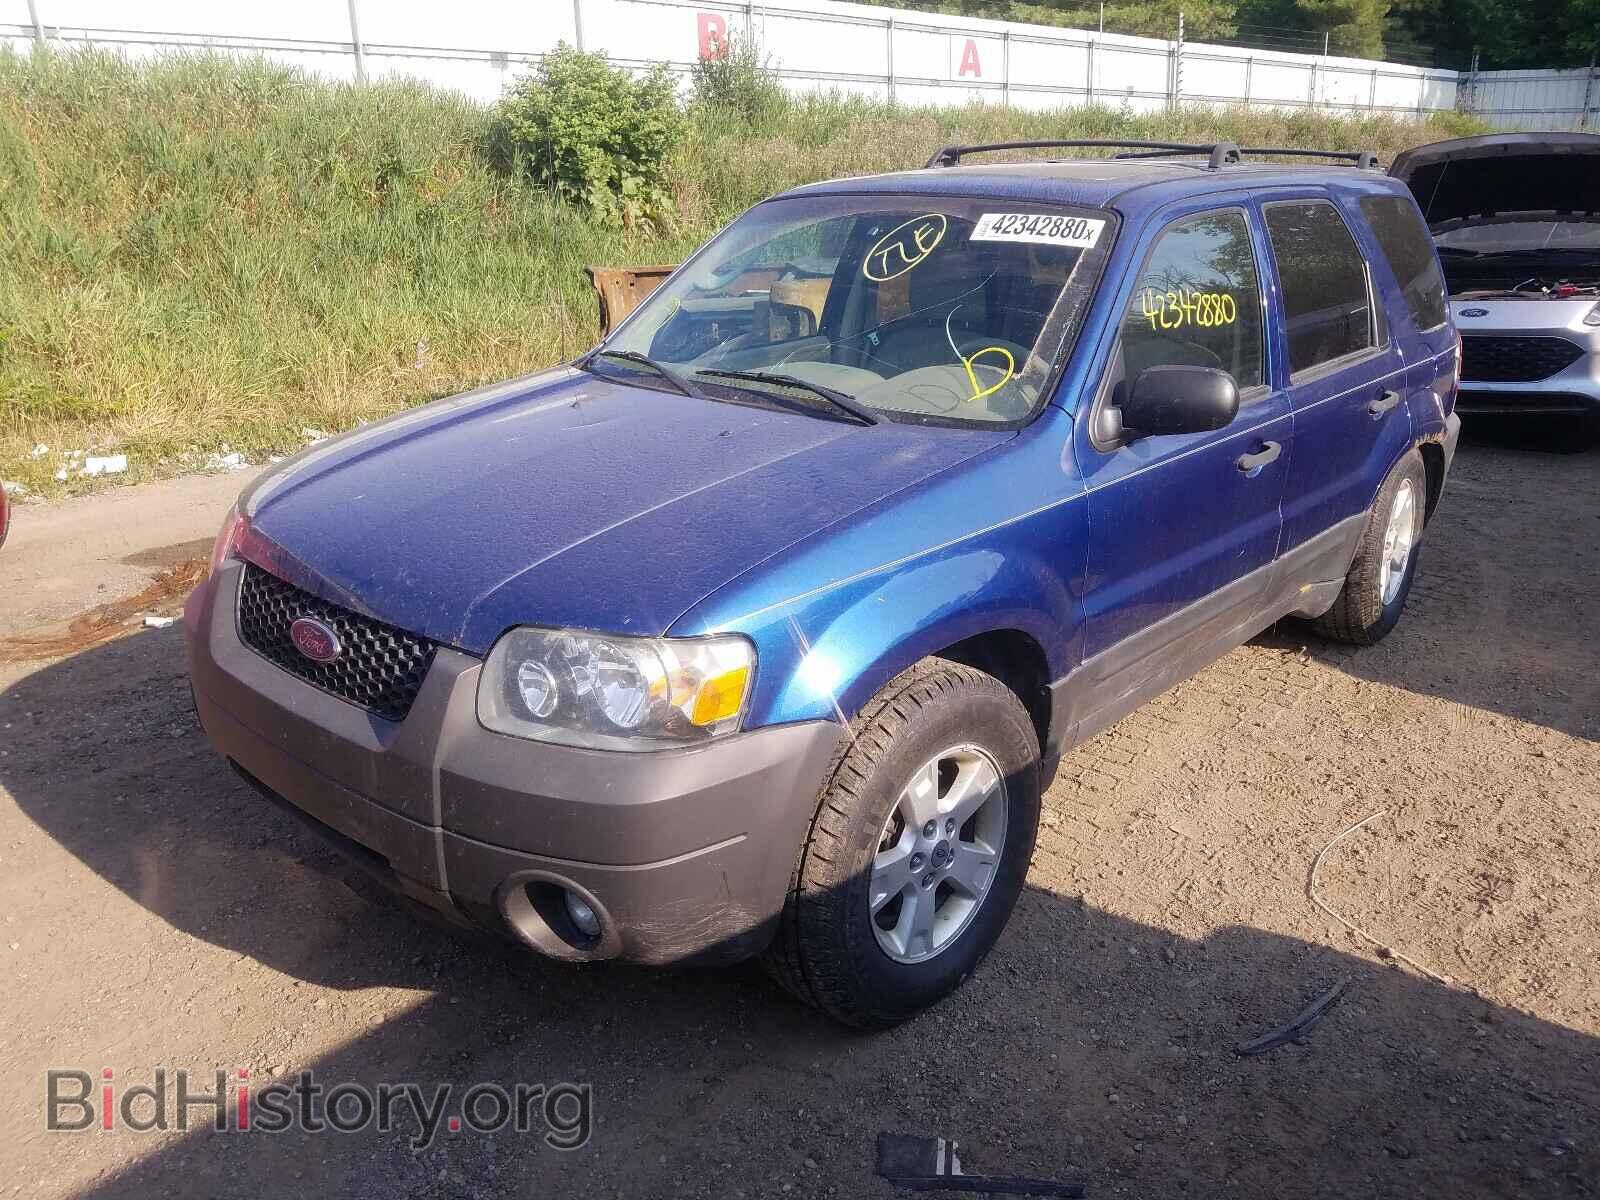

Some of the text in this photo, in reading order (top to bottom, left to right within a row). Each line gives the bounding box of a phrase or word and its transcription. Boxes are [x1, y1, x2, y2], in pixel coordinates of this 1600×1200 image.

[696, 12, 730, 61] B
[958, 39, 982, 78] A
[1142, 288, 1236, 331] 42342880
